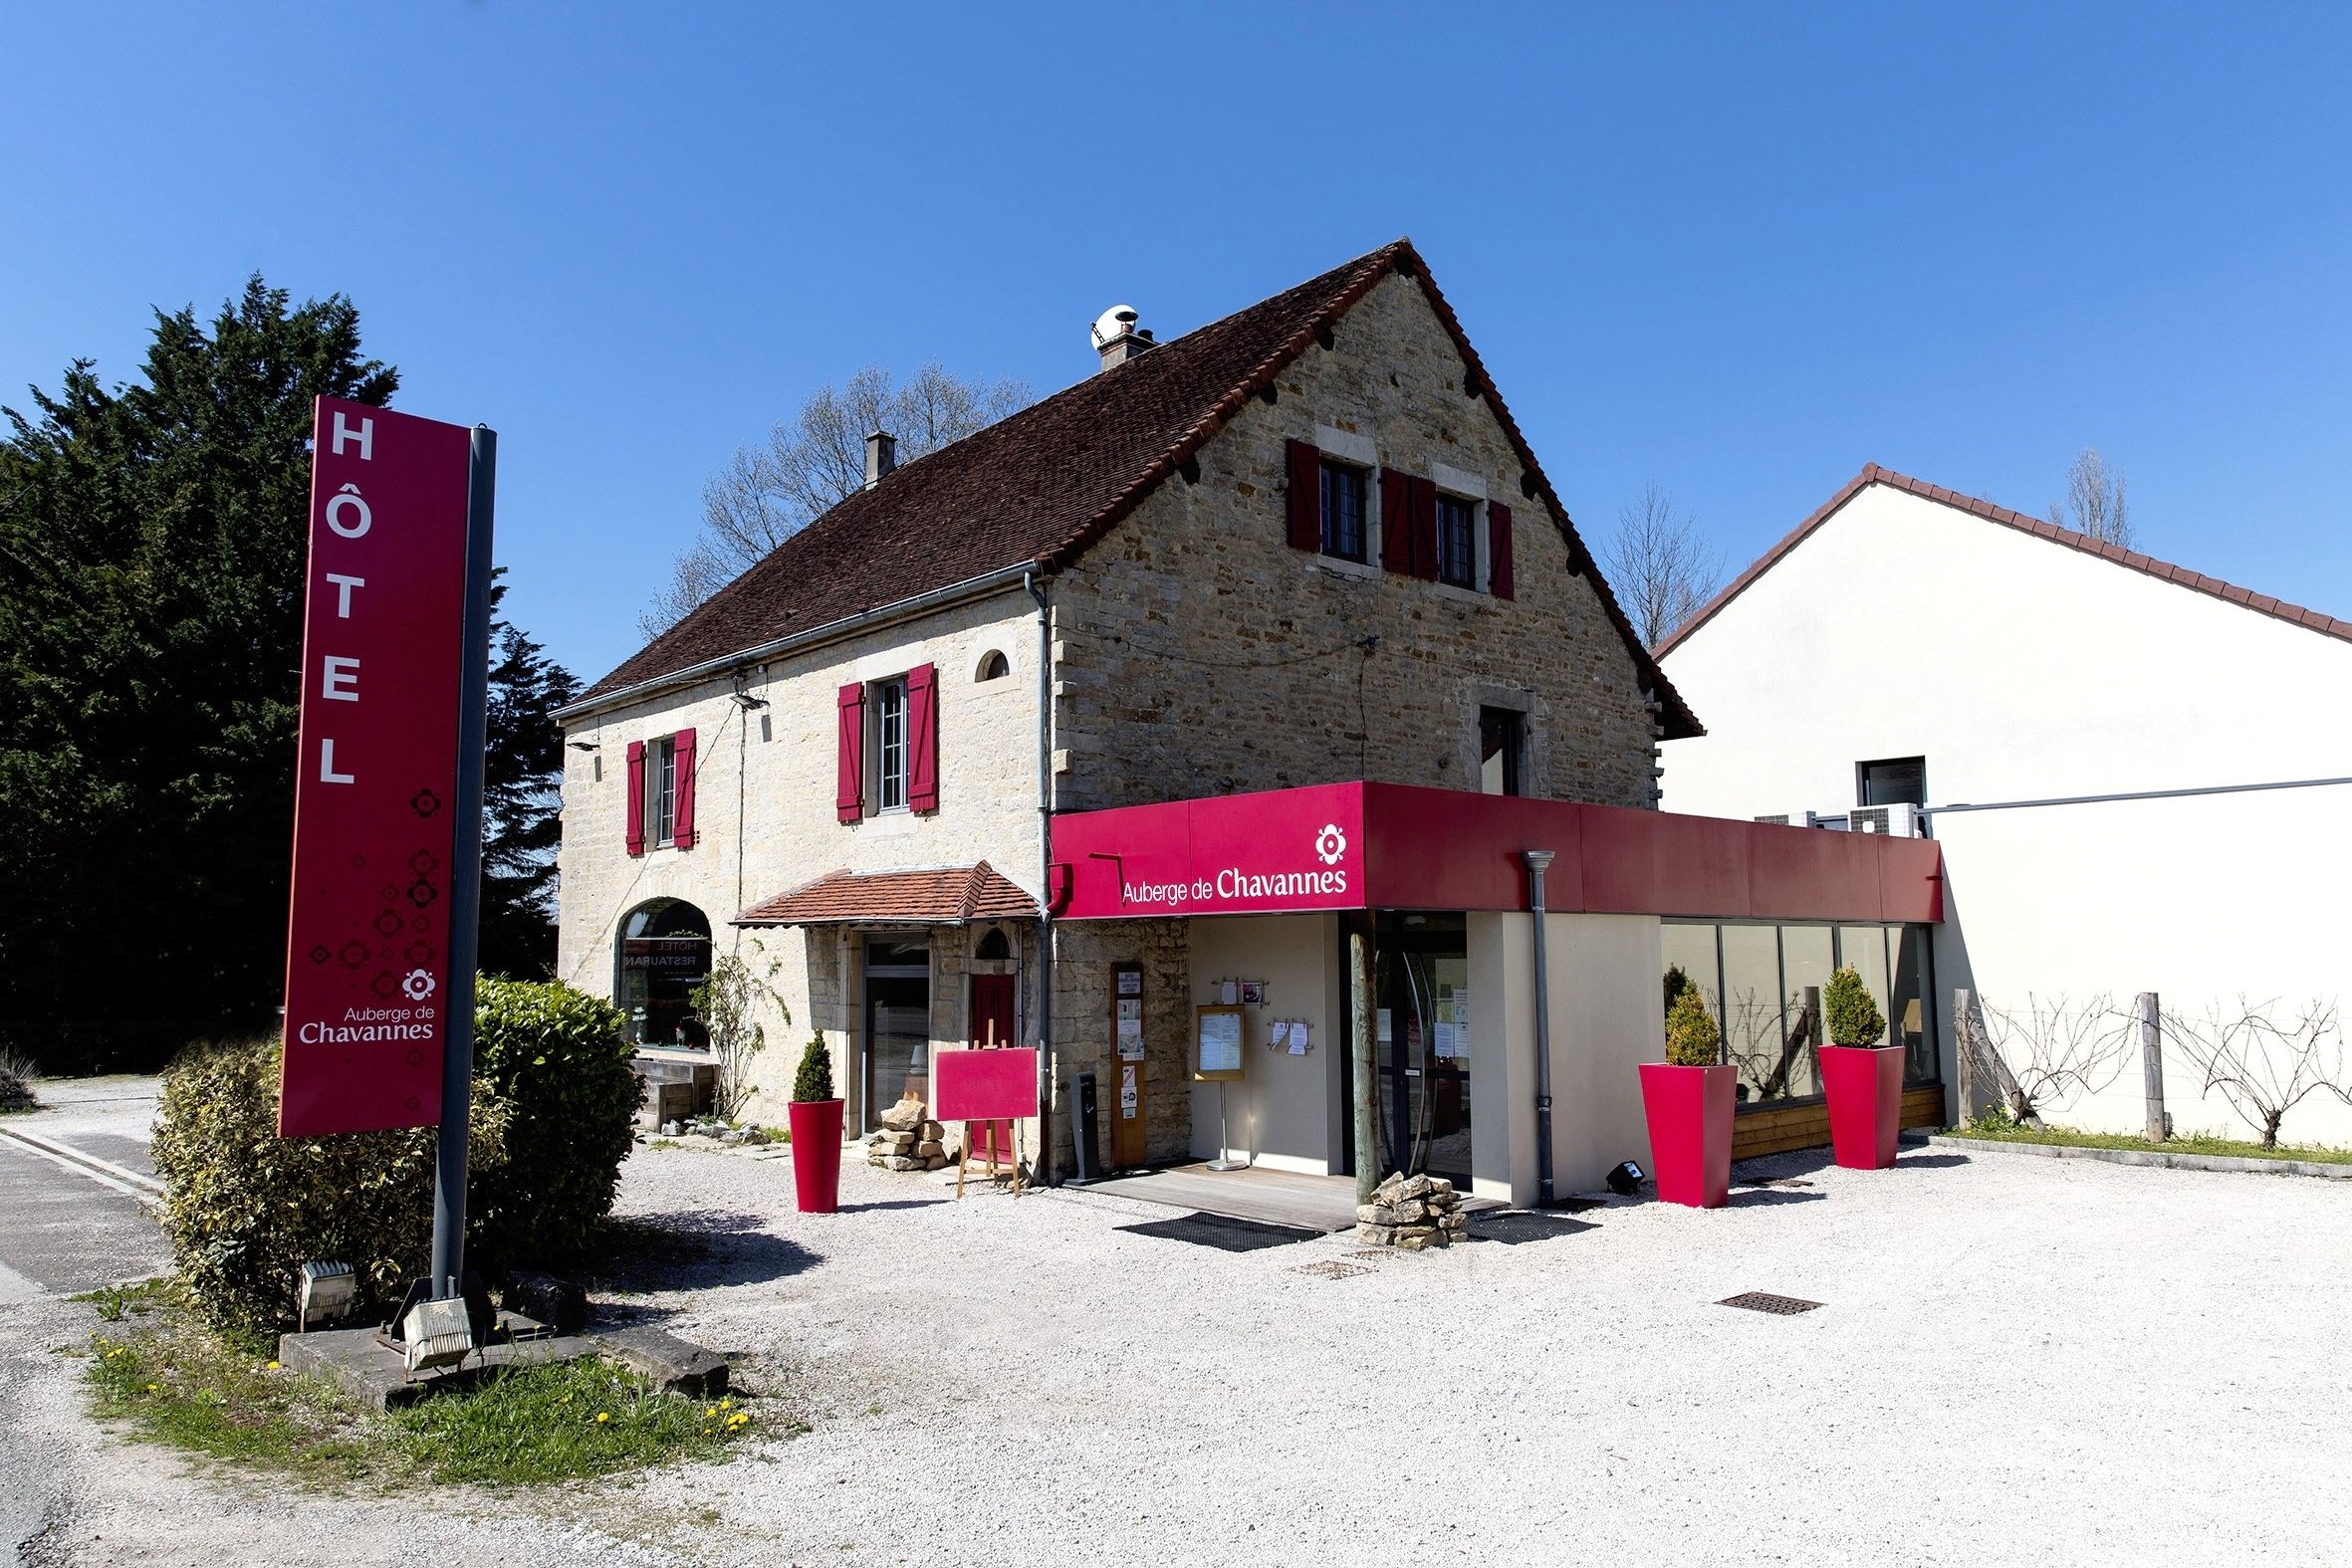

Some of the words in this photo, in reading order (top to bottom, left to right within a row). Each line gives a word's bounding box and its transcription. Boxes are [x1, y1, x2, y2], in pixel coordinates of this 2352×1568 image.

[320, 411, 373, 784] HÔTEL
[1122, 881, 1187, 906] Auberge
[1191, 878, 1213, 900] de
[1216, 868, 1347, 898] Chavannes
[344, 1008, 411, 1022] Auberge
[414, 1007, 434, 1019] de
[300, 1022, 433, 1043] Chavannes
